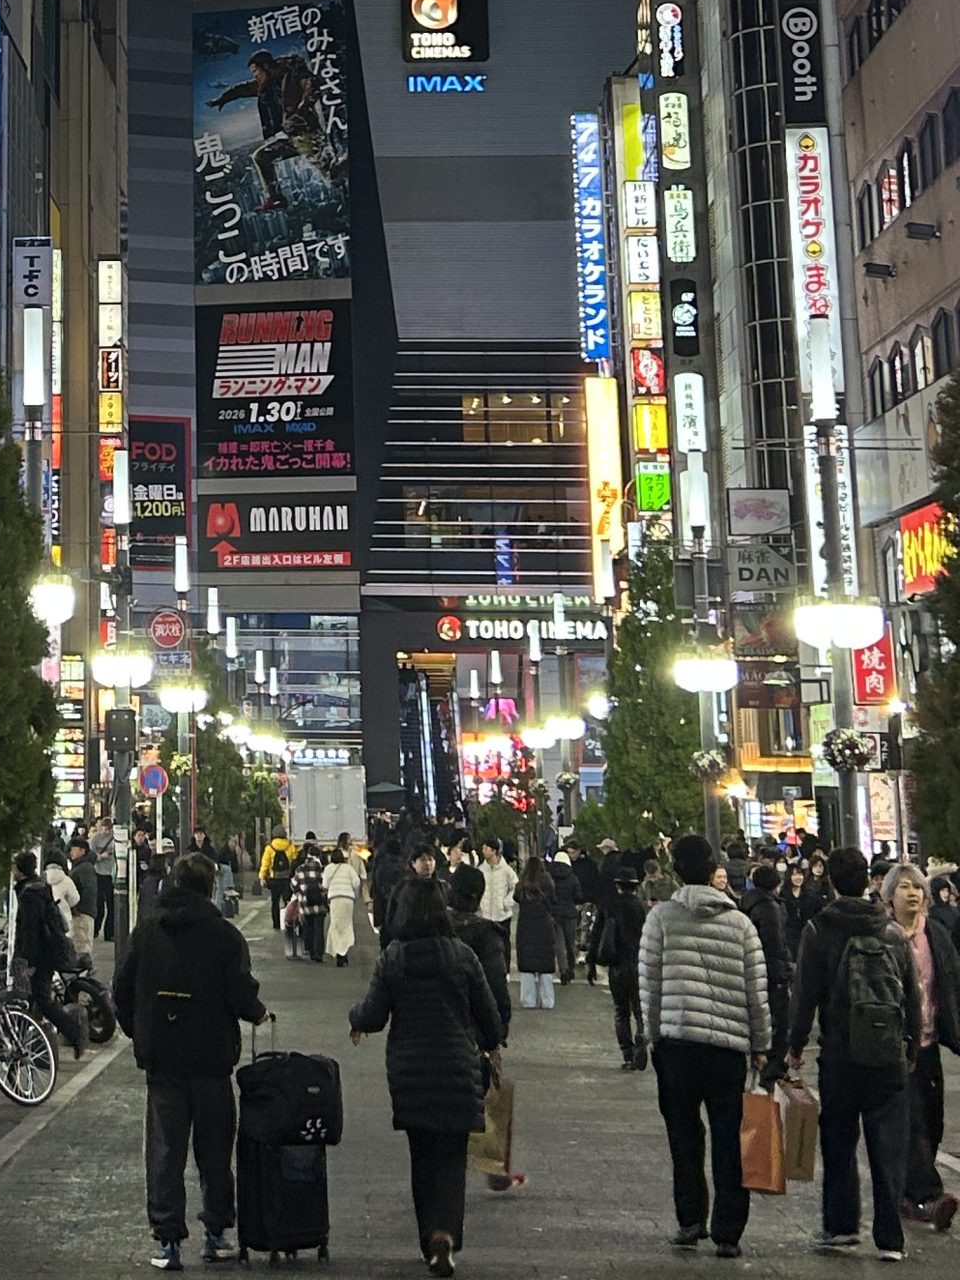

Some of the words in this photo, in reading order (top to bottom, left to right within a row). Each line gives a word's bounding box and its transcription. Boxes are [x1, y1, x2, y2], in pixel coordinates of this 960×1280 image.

[410, 32, 455, 47] TOHO
[410, 45, 471, 59] CINEMAS
[781, 7, 818, 102] Booth
[247, 5, 348, 135] 新宿のみなさん
[407, 75, 486, 93] IMAX
[576, 121, 602, 189] 747
[797, 153, 824, 239] カラオケ
[193, 132, 351, 285] 鬼ごっこの時間です
[580, 195, 608, 352] カラオケランド
[219, 309, 333, 345] RUNNING
[218, 376, 322, 397] ランニング・マン
[218, 409, 246, 421] 2026
[249, 400, 297, 423] 1.30
[233, 422, 275, 434] IMAX
[131, 441, 177, 462] FOD
[203, 452, 352, 472] イカれた鬼ごっこ開幕!
[129, 483, 184, 501] 金曜日は
[249, 504, 349, 533] MARUHAN
[736, 549, 772, 565] 麻雀
[738, 567, 790, 583] DAN
[154, 622, 182, 638] 消火栓
[465, 619, 524, 640] TOHO
[860, 647, 887, 695] 焼肉
